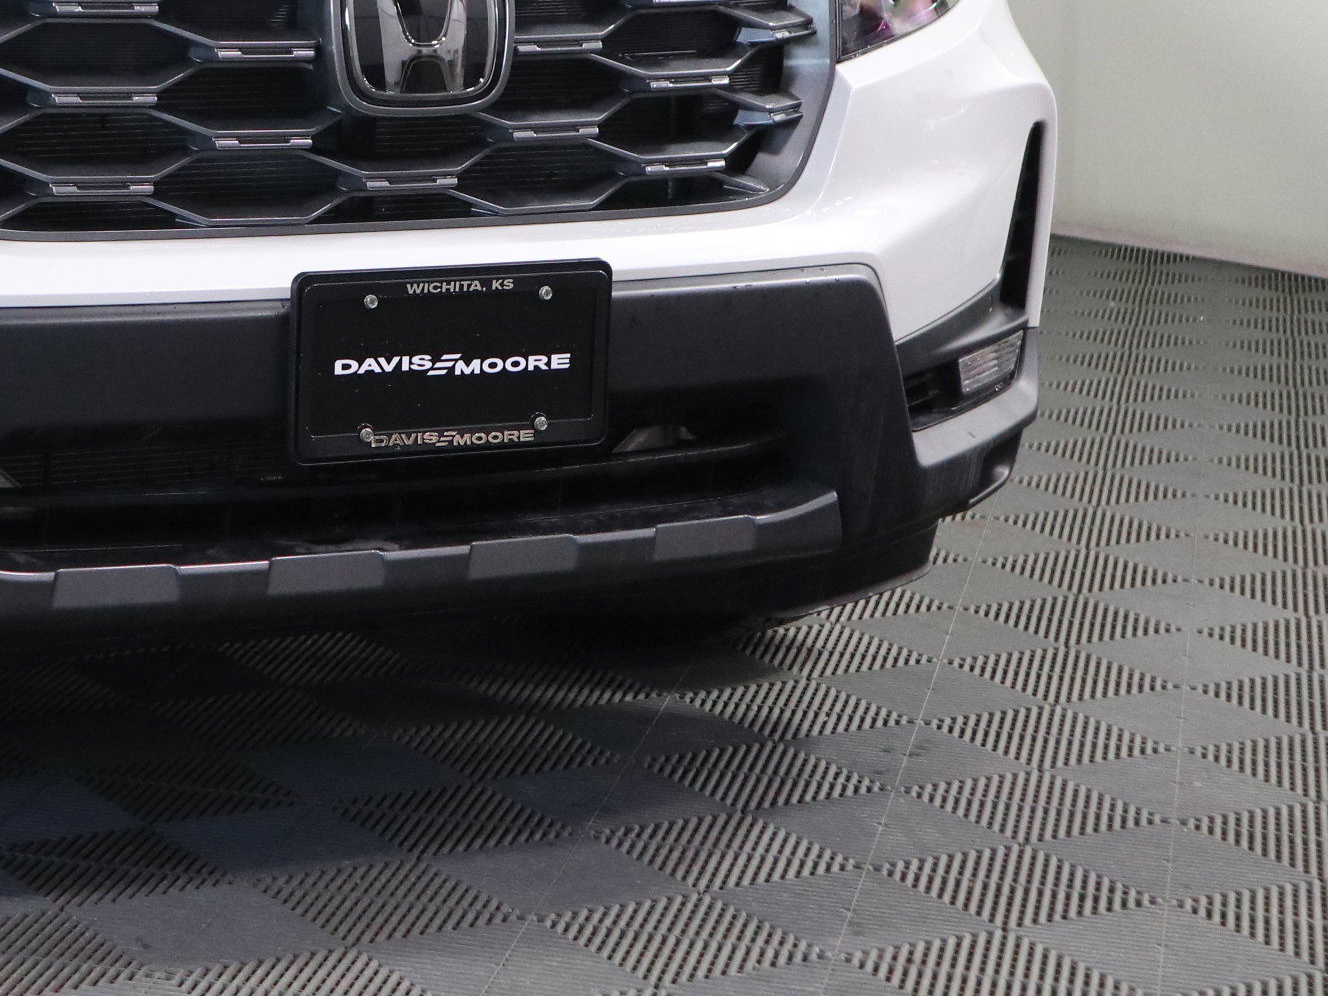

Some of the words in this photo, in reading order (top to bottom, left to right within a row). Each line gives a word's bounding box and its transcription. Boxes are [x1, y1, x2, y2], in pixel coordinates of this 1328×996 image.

[406, 280, 487, 294] WICHITA,
[492, 279, 514, 290] KS
[333, 354, 432, 375] DAVIS
[454, 353, 571, 375] MOORE
[371, 431, 439, 447] DAVIS
[452, 429, 535, 446] MOORE
